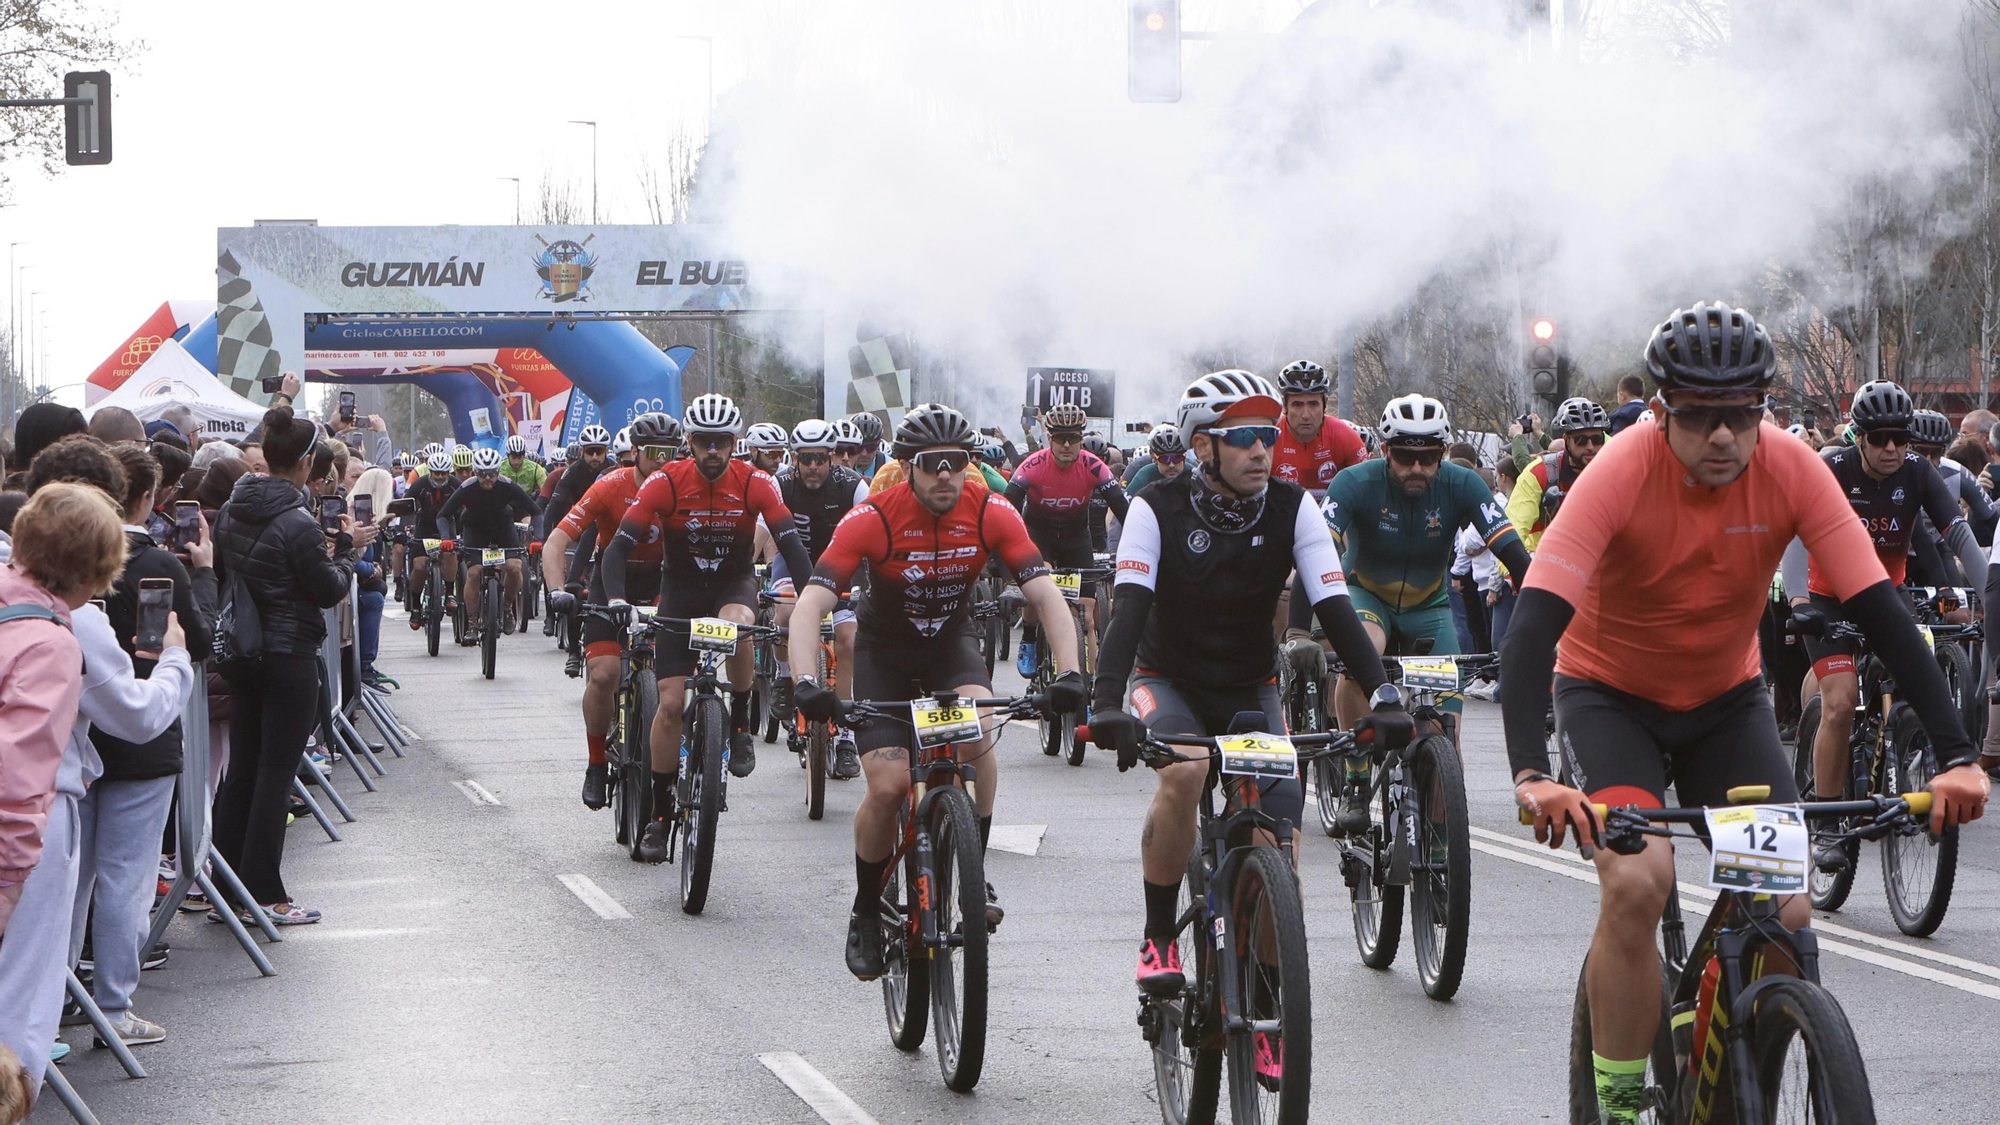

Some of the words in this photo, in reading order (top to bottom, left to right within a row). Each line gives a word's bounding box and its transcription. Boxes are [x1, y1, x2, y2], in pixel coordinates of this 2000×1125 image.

[341, 256, 485, 288] GUZMÁN
[636, 261, 673, 286] EL
[1054, 372, 1088, 383] ACCESO
[1050, 385, 1092, 408] MTB
[1182, 402, 1207, 410] SCOTT
[1041, 496, 1085, 507] RCN
[697, 623, 732, 636] 2917
[928, 710, 963, 723] 589
[1405, 815, 1416, 848] FOX
[1743, 823, 1777, 852] 12
